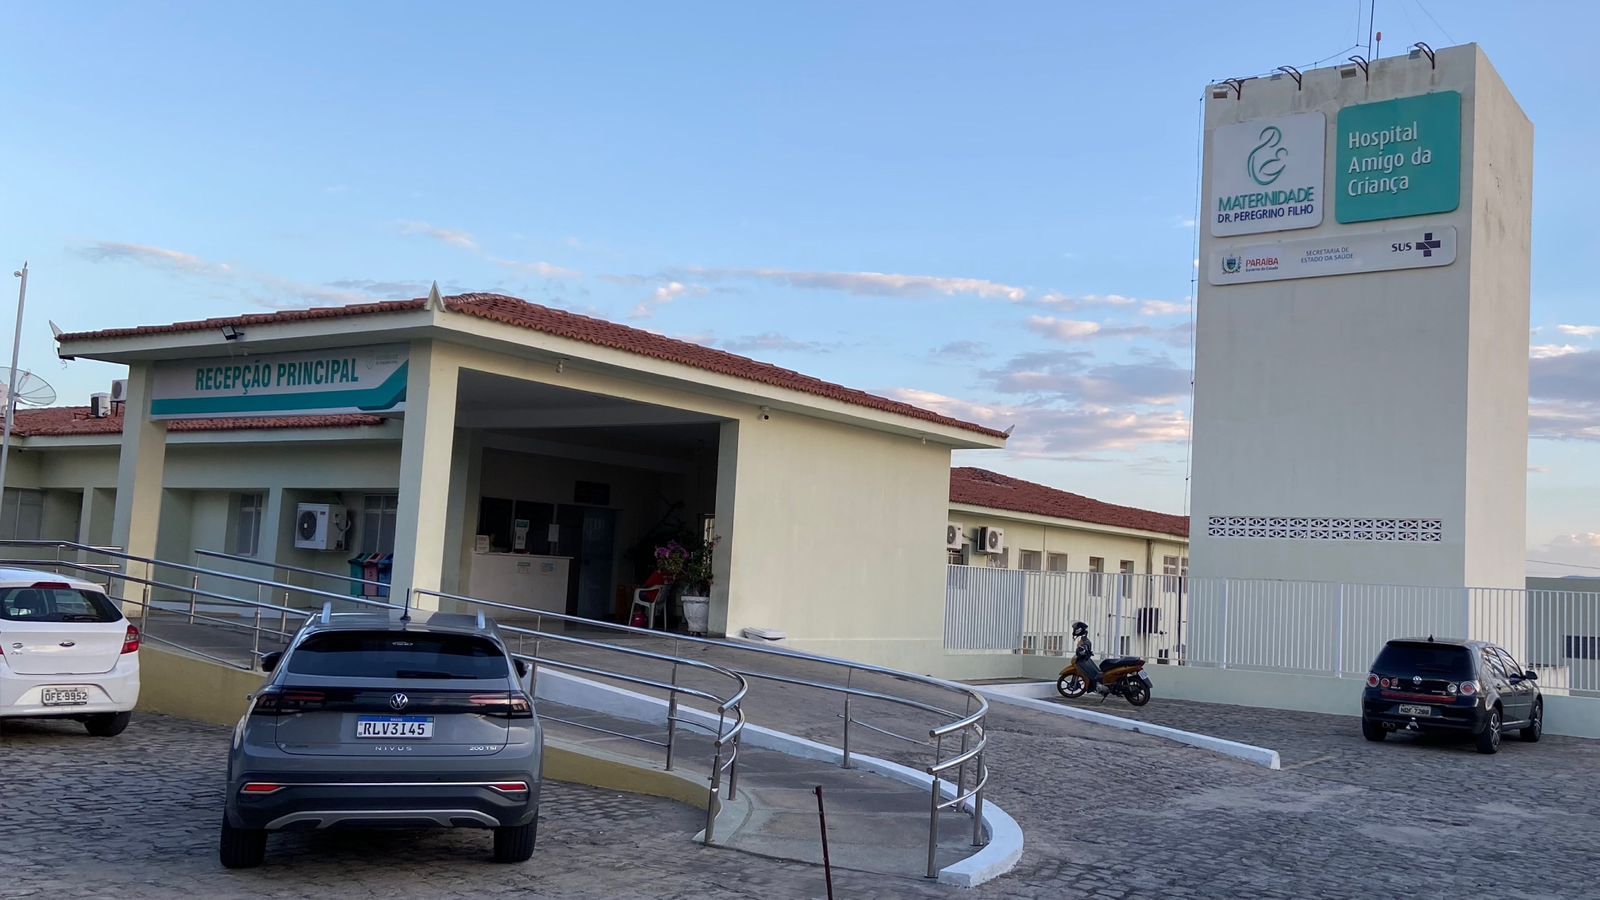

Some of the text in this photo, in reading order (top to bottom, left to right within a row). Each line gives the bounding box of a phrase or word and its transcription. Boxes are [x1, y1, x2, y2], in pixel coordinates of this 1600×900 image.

[1348, 121, 1417, 150] Hospital
[1348, 146, 1432, 174] Amigo da
[1348, 175, 1409, 196] Criança
[1218, 186, 1315, 212] MATERNIDADE
[1234, 207, 1285, 222] PEREGRINO
[1287, 204, 1314, 216] FILHO
[1306, 248, 1340, 256] SECRETARIA
[1391, 242, 1412, 252] SUS
[1300, 255, 1323, 263] ESTADO
[195, 358, 359, 395] RECEPÇÃO PRINCIPAL
[363, 722, 425, 735] RLV3I45
